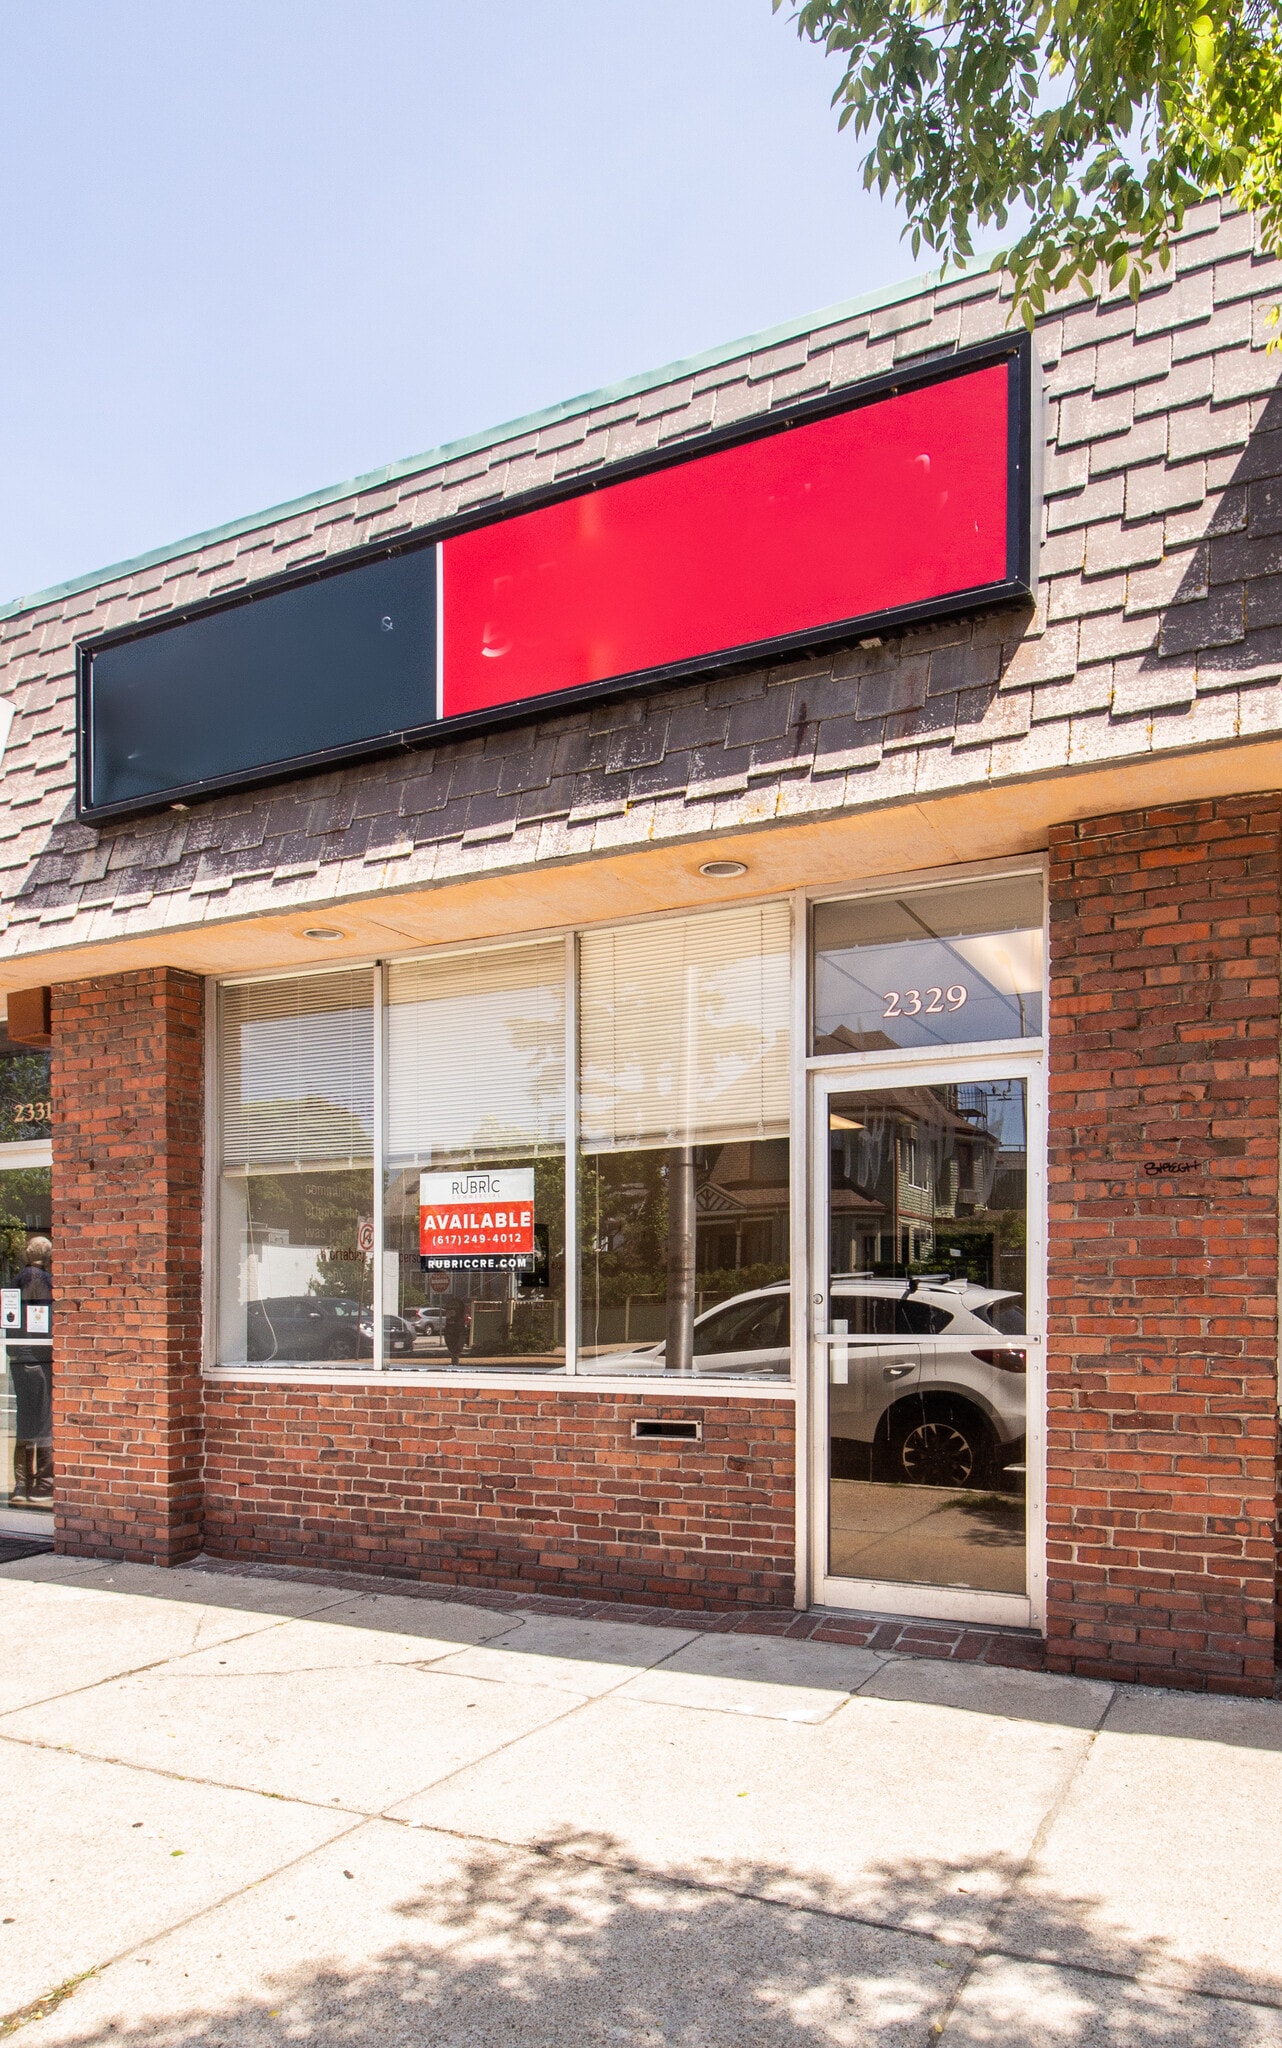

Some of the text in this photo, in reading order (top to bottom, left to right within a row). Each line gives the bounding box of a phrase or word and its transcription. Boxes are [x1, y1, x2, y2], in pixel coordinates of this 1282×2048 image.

[882, 984, 968, 1018] 2329
[13, 1101, 51, 1123] 2331
[451, 1174, 501, 1195] RUBRIC
[423, 1211, 532, 1231] AVAILABLE
[432, 1233, 522, 1246] (617)249-4012
[427, 1259, 527, 1269] RUBRICCRE.COM
